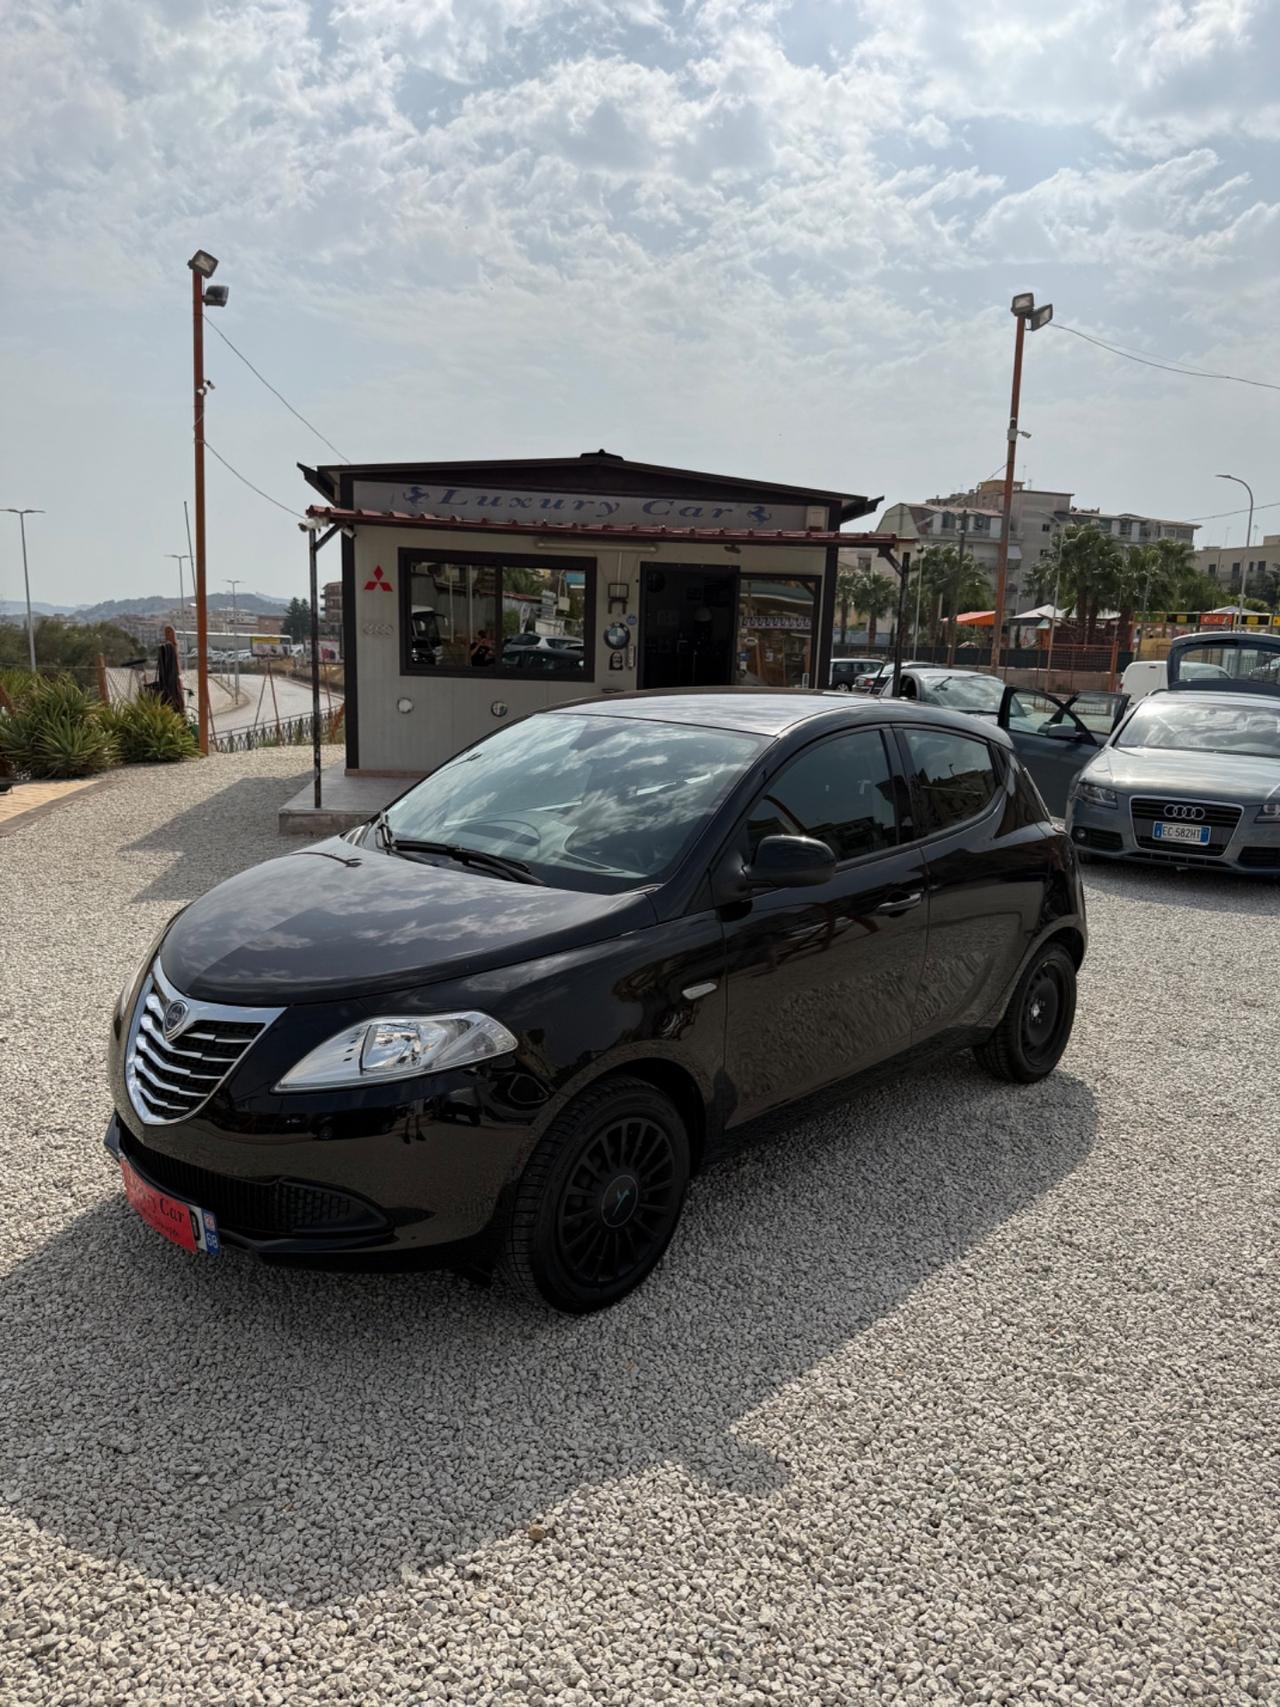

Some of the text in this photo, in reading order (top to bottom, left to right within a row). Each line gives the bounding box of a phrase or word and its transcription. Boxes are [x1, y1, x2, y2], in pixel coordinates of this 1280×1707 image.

[439, 488, 733, 521] Luxury Car
[159, 1197, 185, 1223] Car
